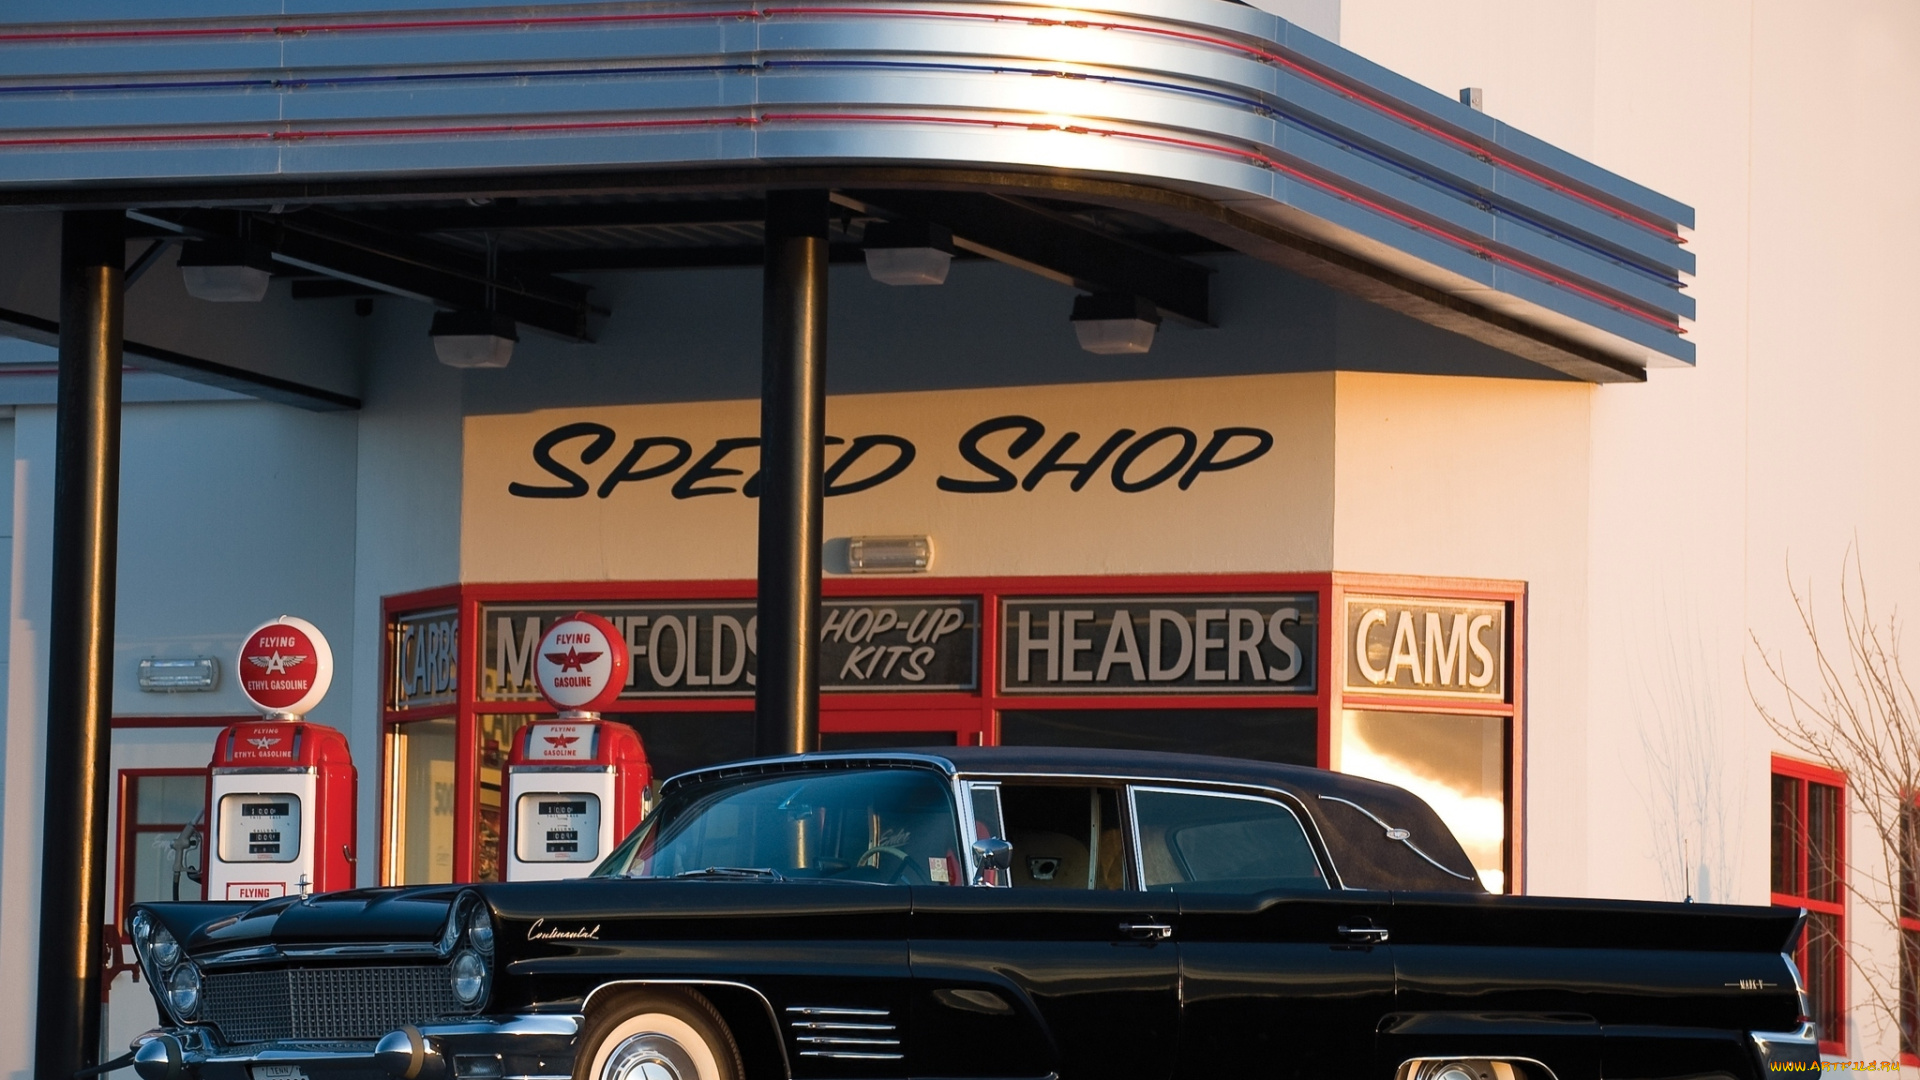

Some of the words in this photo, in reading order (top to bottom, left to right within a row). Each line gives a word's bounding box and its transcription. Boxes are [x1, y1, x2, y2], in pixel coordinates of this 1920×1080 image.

[508, 422, 917, 499] SPED
[936, 415, 1274, 493] SHOP
[820, 608, 965, 643] HOP-UP
[259, 636, 295, 648] FLYING
[556, 633, 591, 645] FLYING
[1017, 607, 1302, 682] HEADERS
[1356, 608, 1494, 688] CAMS
[839, 645, 936, 682] KITS
[247, 680, 269, 691] ETHYL
[270, 679, 308, 690] GASOLINE
[554, 676, 592, 688] GASOLINE
[234, 750, 256, 758] ETHYL
[258, 750, 292, 758] GASOLINE
[239, 888, 270, 898] FLYING
[527, 917, 600, 941] Continental
[270, 1065, 289, 1074] TENN
